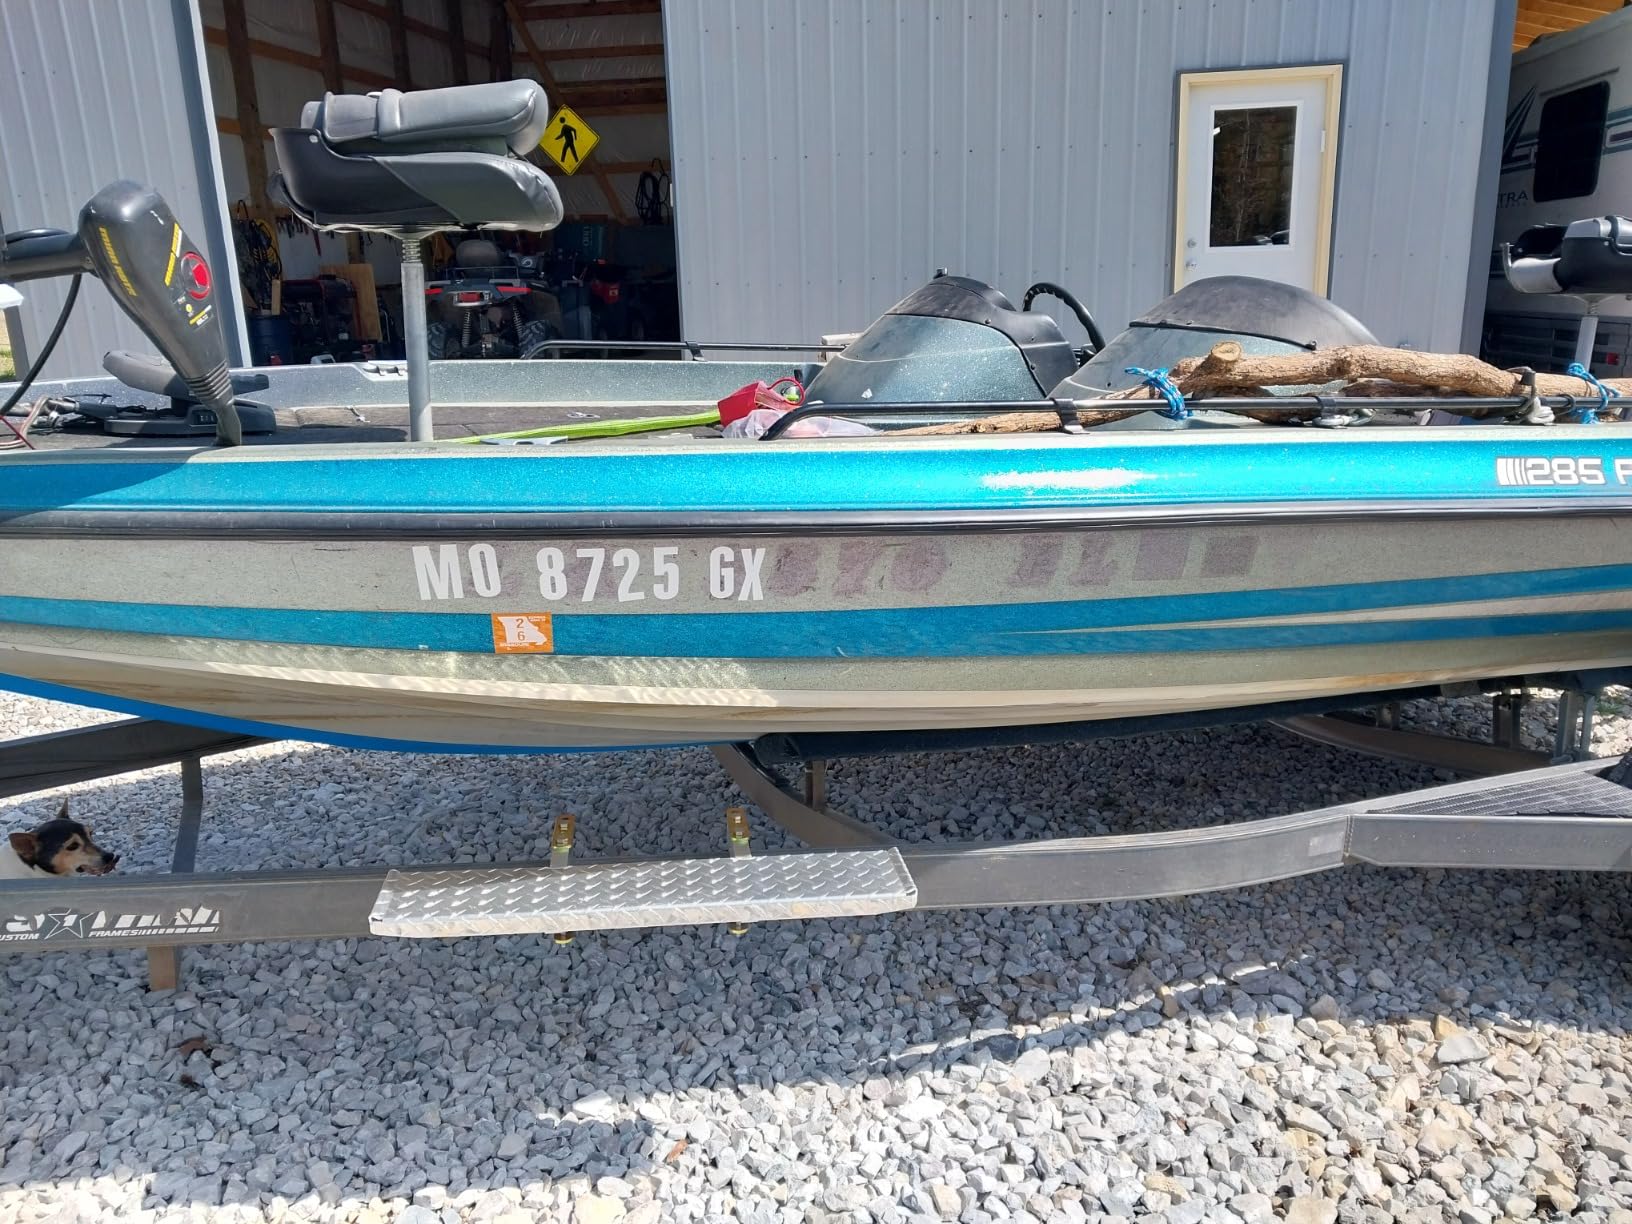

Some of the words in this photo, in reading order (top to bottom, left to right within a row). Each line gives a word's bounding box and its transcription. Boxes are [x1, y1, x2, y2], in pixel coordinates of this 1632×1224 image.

[1525, 457, 1606, 485] 285
[412, 543, 501, 601] MO
[536, 546, 679, 602] 8725
[709, 546, 766, 601] GX
[88, 929, 141, 938] FRAMES
